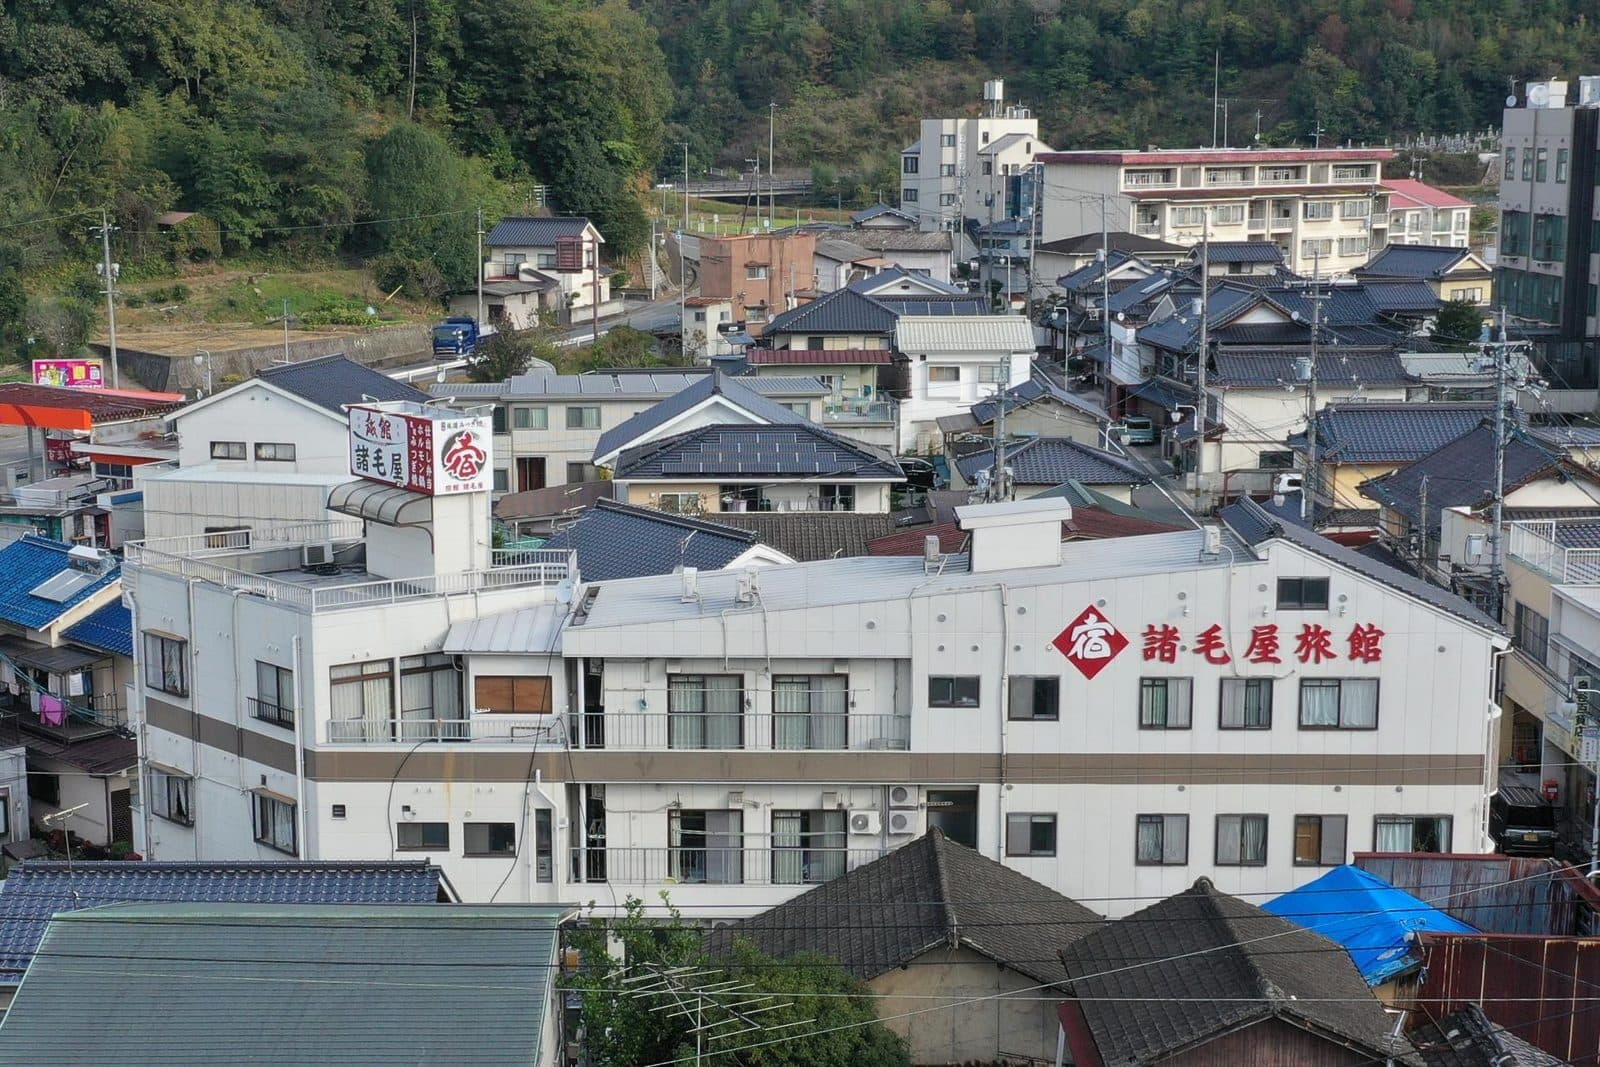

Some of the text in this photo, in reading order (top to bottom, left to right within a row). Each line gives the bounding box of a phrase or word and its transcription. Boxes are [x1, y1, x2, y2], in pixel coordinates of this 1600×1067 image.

[354, 443, 404, 481] 諸毛屋
[424, 424, 433, 490] 仕出し弁当
[1067, 612, 1115, 660] 宿
[1140, 622, 1386, 665] 諸毛屋旅館
